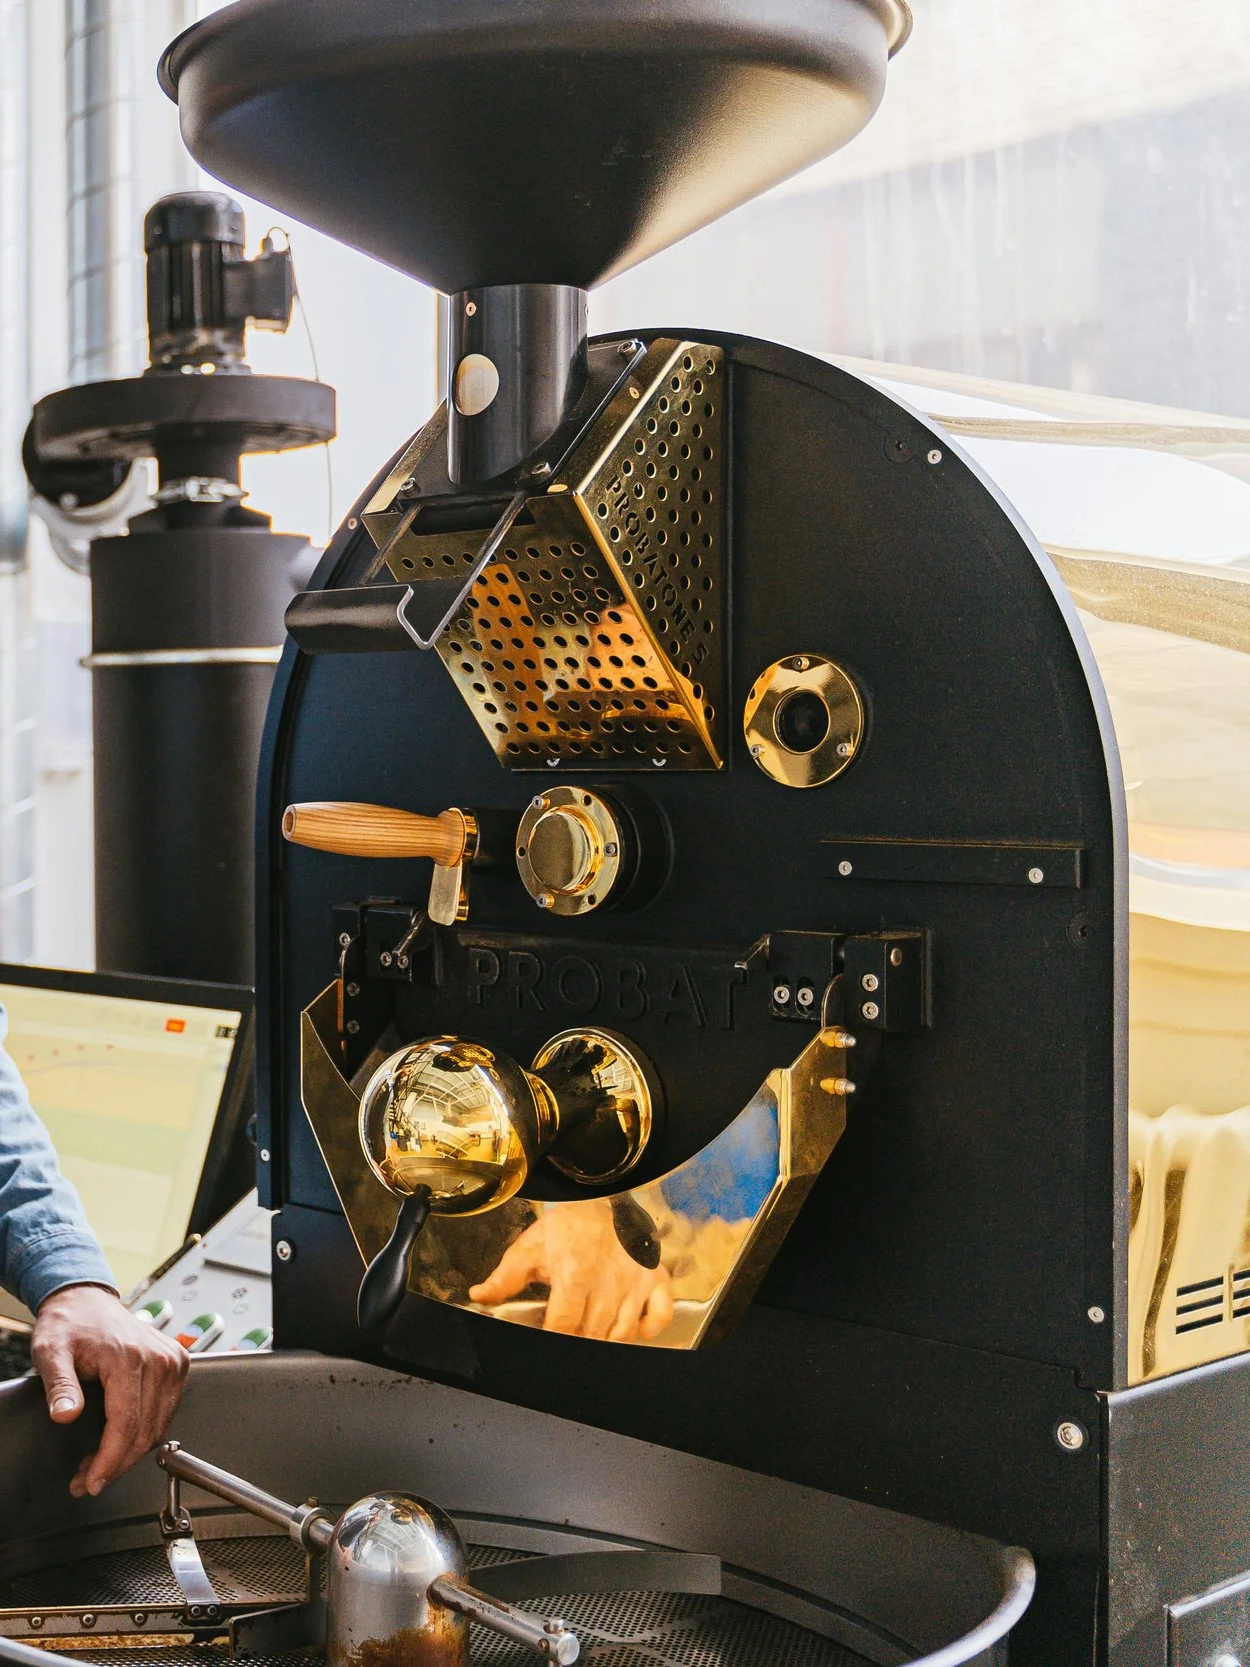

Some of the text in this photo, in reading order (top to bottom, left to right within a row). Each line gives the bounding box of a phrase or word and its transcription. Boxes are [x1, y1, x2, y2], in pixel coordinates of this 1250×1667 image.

[605, 474, 709, 665] PROBATONE 5
[468, 946, 748, 1031] PROBAT
